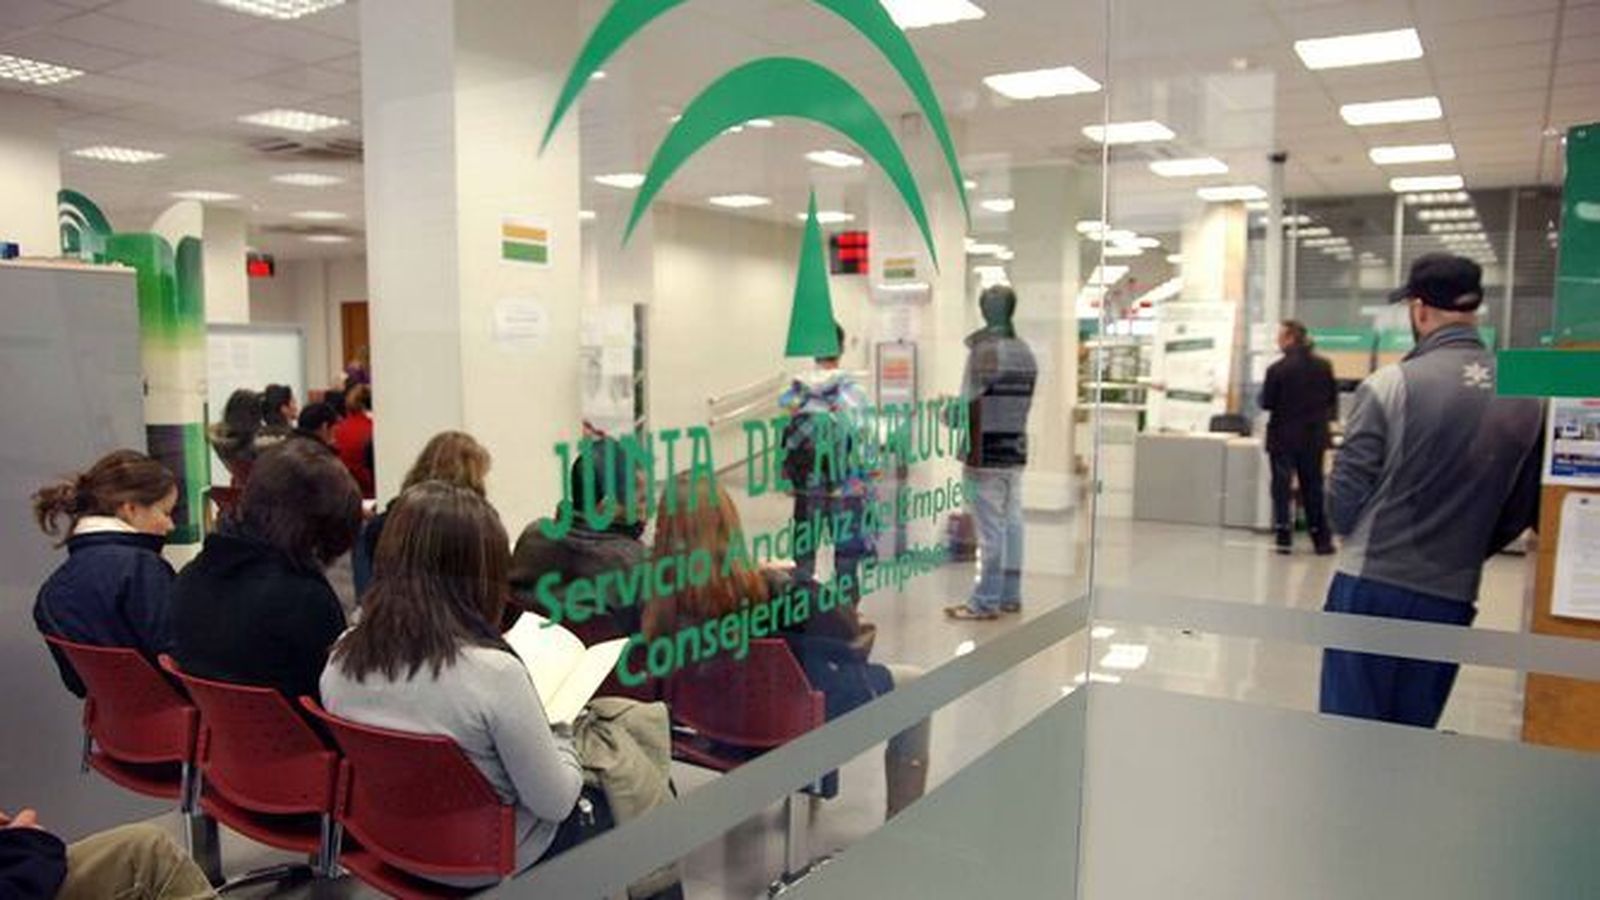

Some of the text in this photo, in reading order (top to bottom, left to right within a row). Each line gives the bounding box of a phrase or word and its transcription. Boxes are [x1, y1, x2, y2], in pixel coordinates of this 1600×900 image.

[538, 427, 721, 540] JUNTA
[742, 414, 793, 497] DE
[536, 541, 712, 630] Servicio
[721, 508, 855, 578] Andaluz
[861, 498, 893, 537] de
[818, 570, 852, 612] de
[858, 541, 947, 596] Empleo
